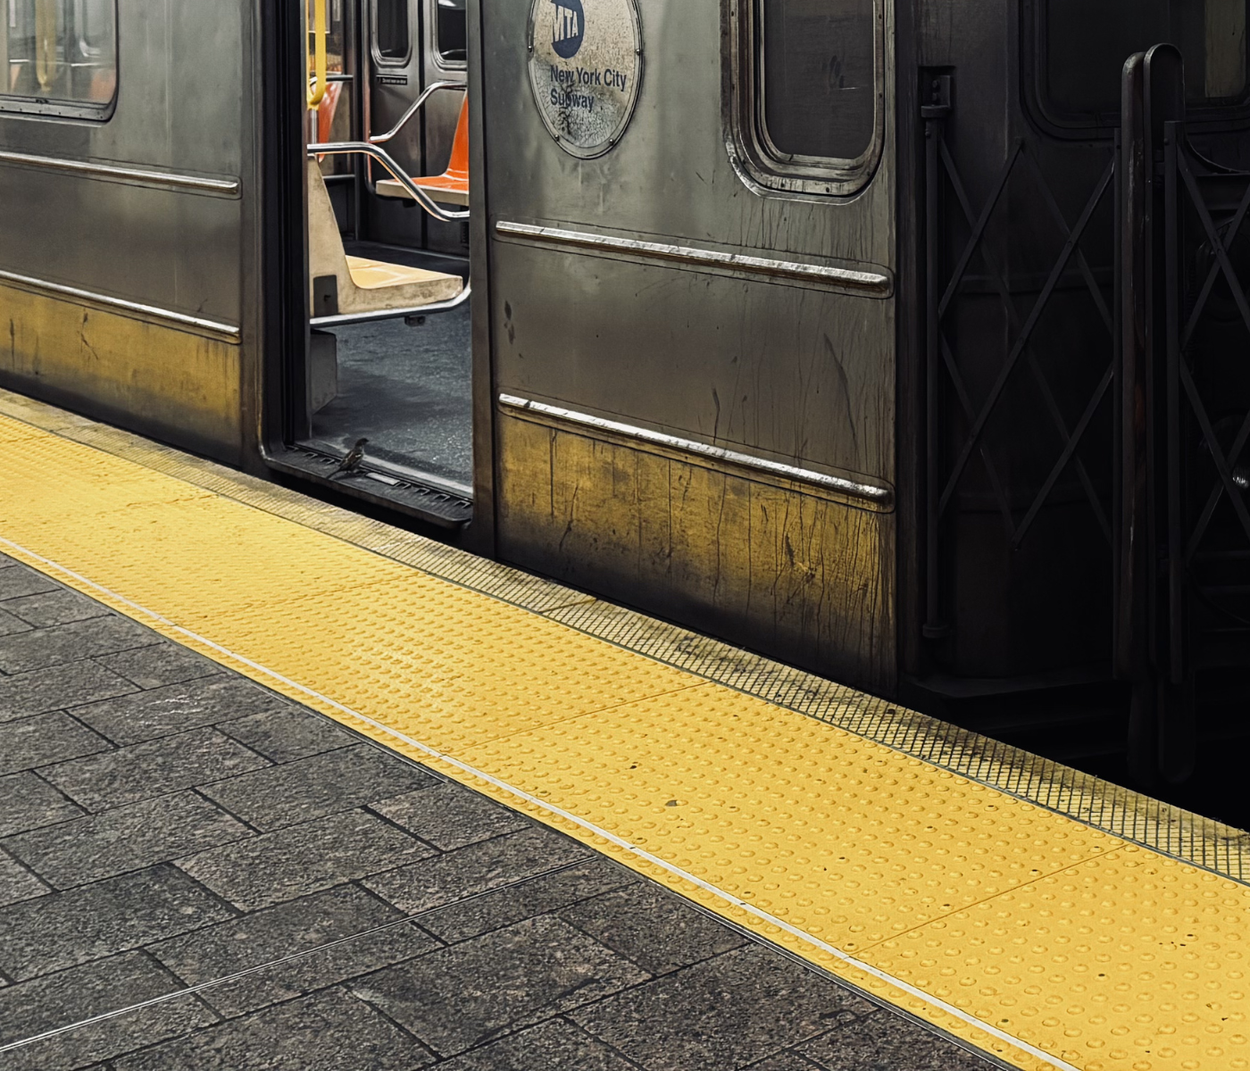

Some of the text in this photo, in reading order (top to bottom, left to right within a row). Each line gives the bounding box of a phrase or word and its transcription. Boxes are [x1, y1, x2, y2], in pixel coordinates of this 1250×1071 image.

[550, 64, 627, 92] New York City
[550, 87, 595, 114] Subway
